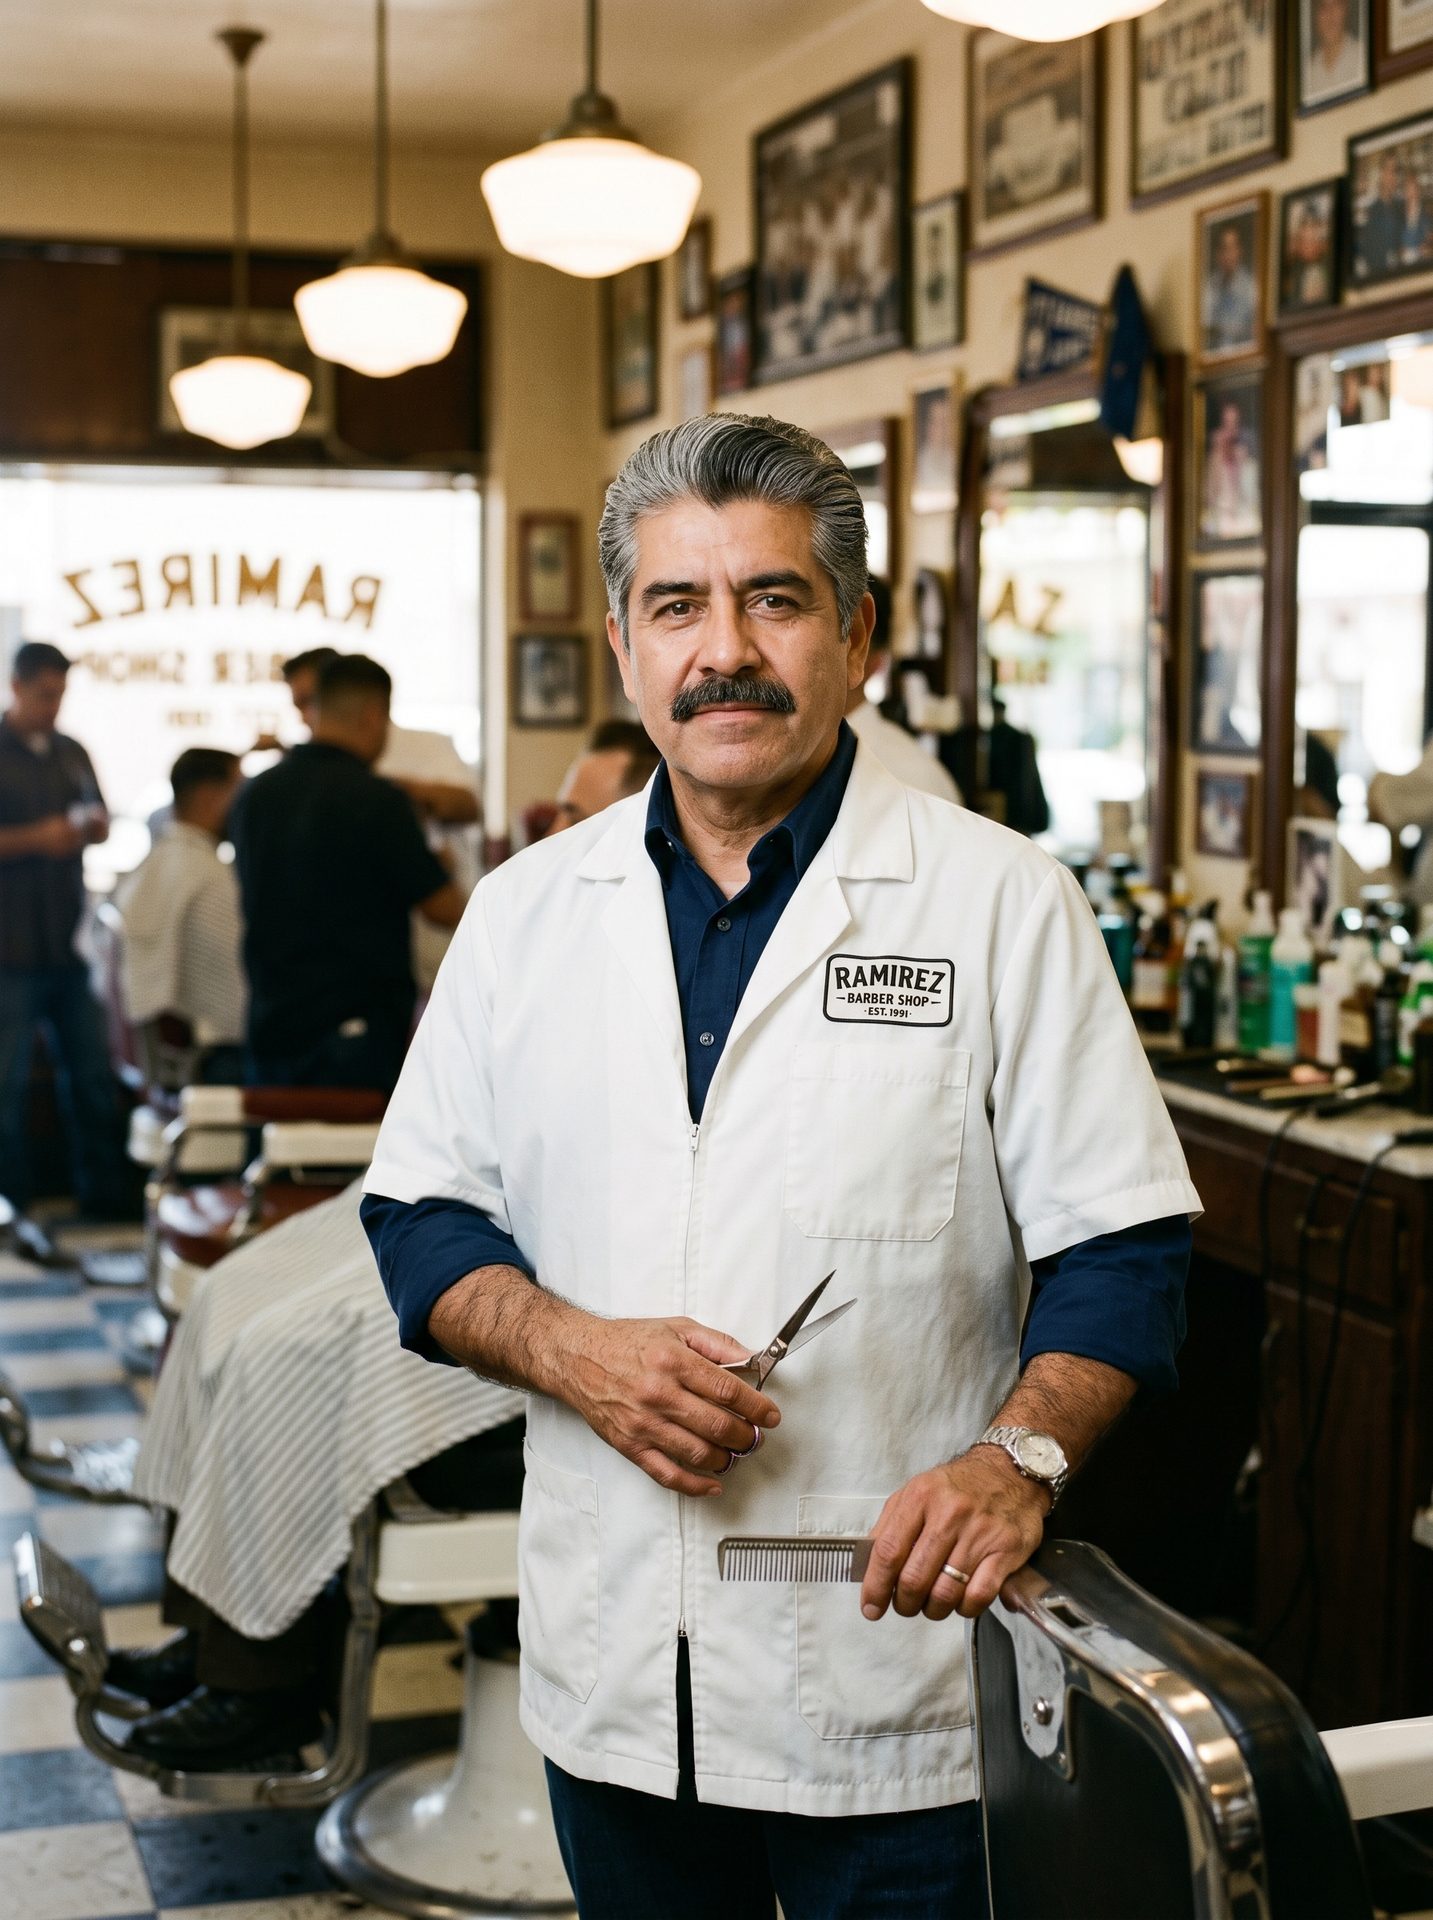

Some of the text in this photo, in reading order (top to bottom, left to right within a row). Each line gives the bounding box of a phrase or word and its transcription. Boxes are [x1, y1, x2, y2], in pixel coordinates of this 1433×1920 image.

[834, 964, 946, 994] RAMIREZ
[847, 992, 930, 1007] BARBER SHOP
[868, 1007, 909, 1018] EST. 1991
